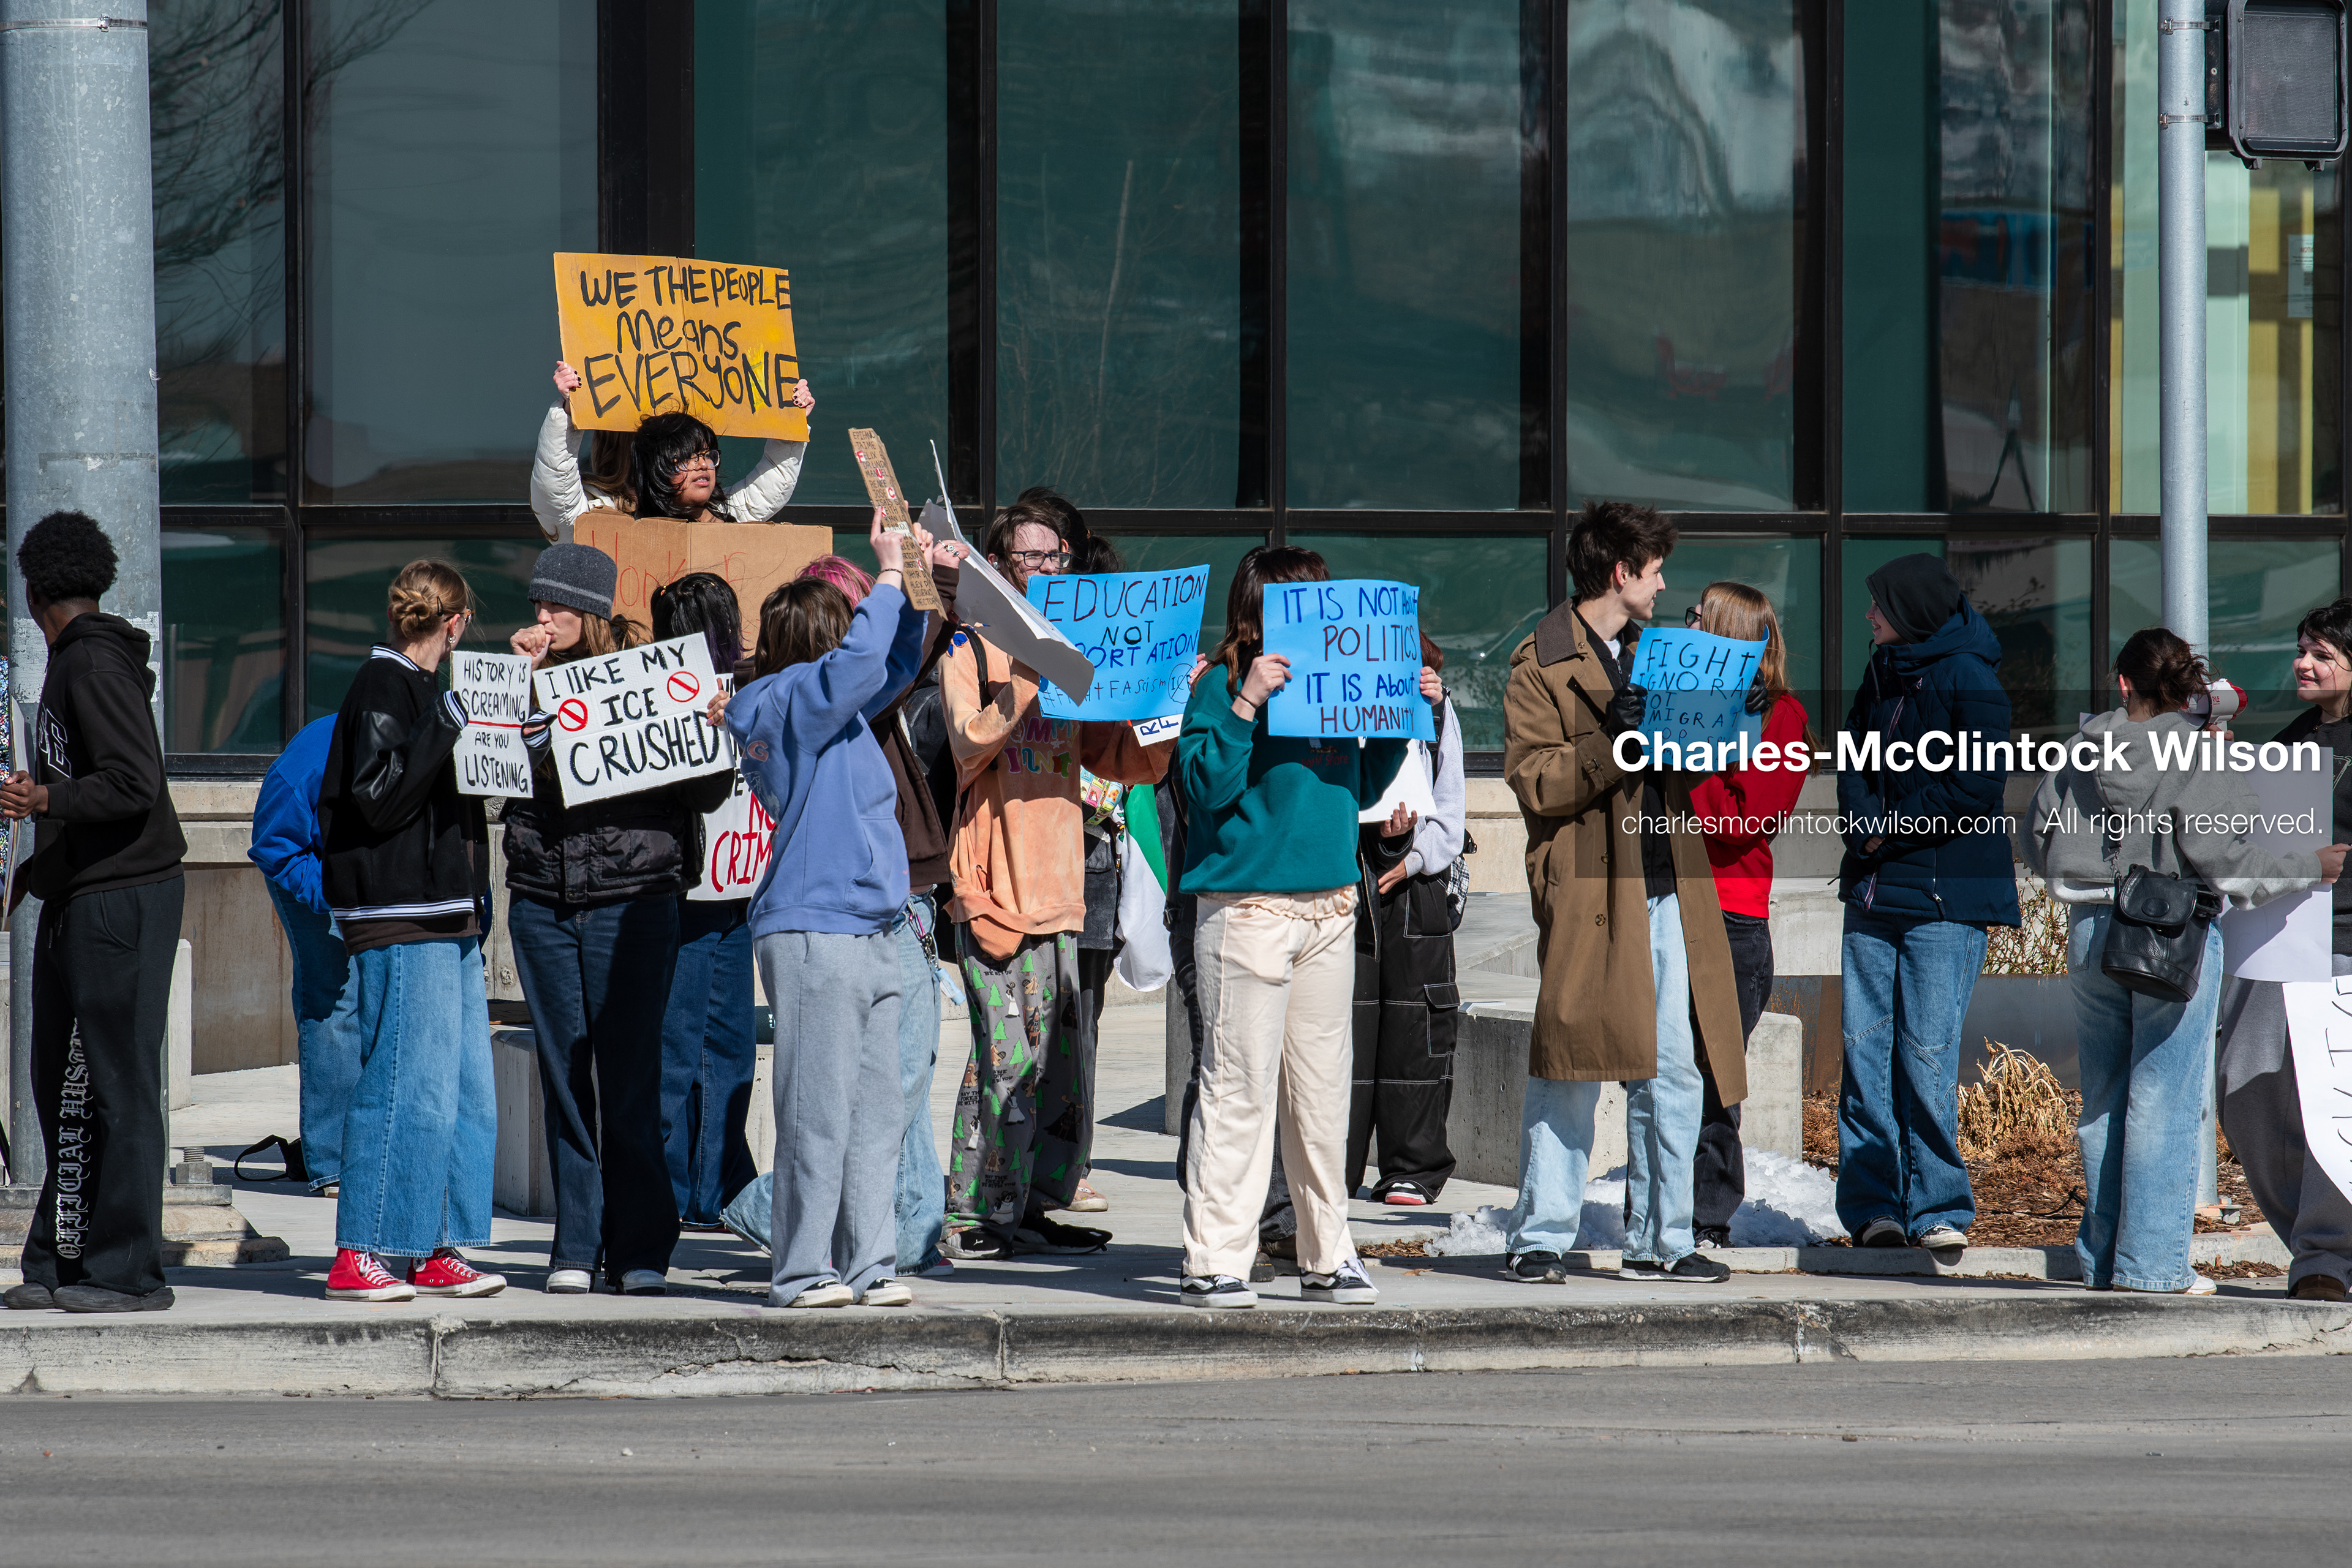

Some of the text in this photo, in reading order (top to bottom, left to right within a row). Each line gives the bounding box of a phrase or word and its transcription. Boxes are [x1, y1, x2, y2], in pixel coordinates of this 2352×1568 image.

[581, 269, 637, 309] WE
[584, 350, 802, 418] EVERYONE
[1044, 573, 1207, 622] EDUCATION
[1284, 588, 1307, 624] IT
[1317, 587, 1344, 621] IS
[1359, 586, 1398, 618] NOT
[1101, 620, 1154, 647] NOT
[1323, 624, 1417, 662] POLITICS
[464, 659, 513, 685] HISTORY
[545, 671, 560, 699] I
[640, 643, 685, 674] MY
[1306, 672, 1415, 704] IT IS About
[462, 690, 526, 724] SCREAMING
[603, 687, 659, 727] ICE
[475, 733, 510, 750] ARE YOU
[569, 709, 720, 786] CRUSHED
[466, 755, 529, 793] LISTENING
[711, 830, 772, 893] CRIM
